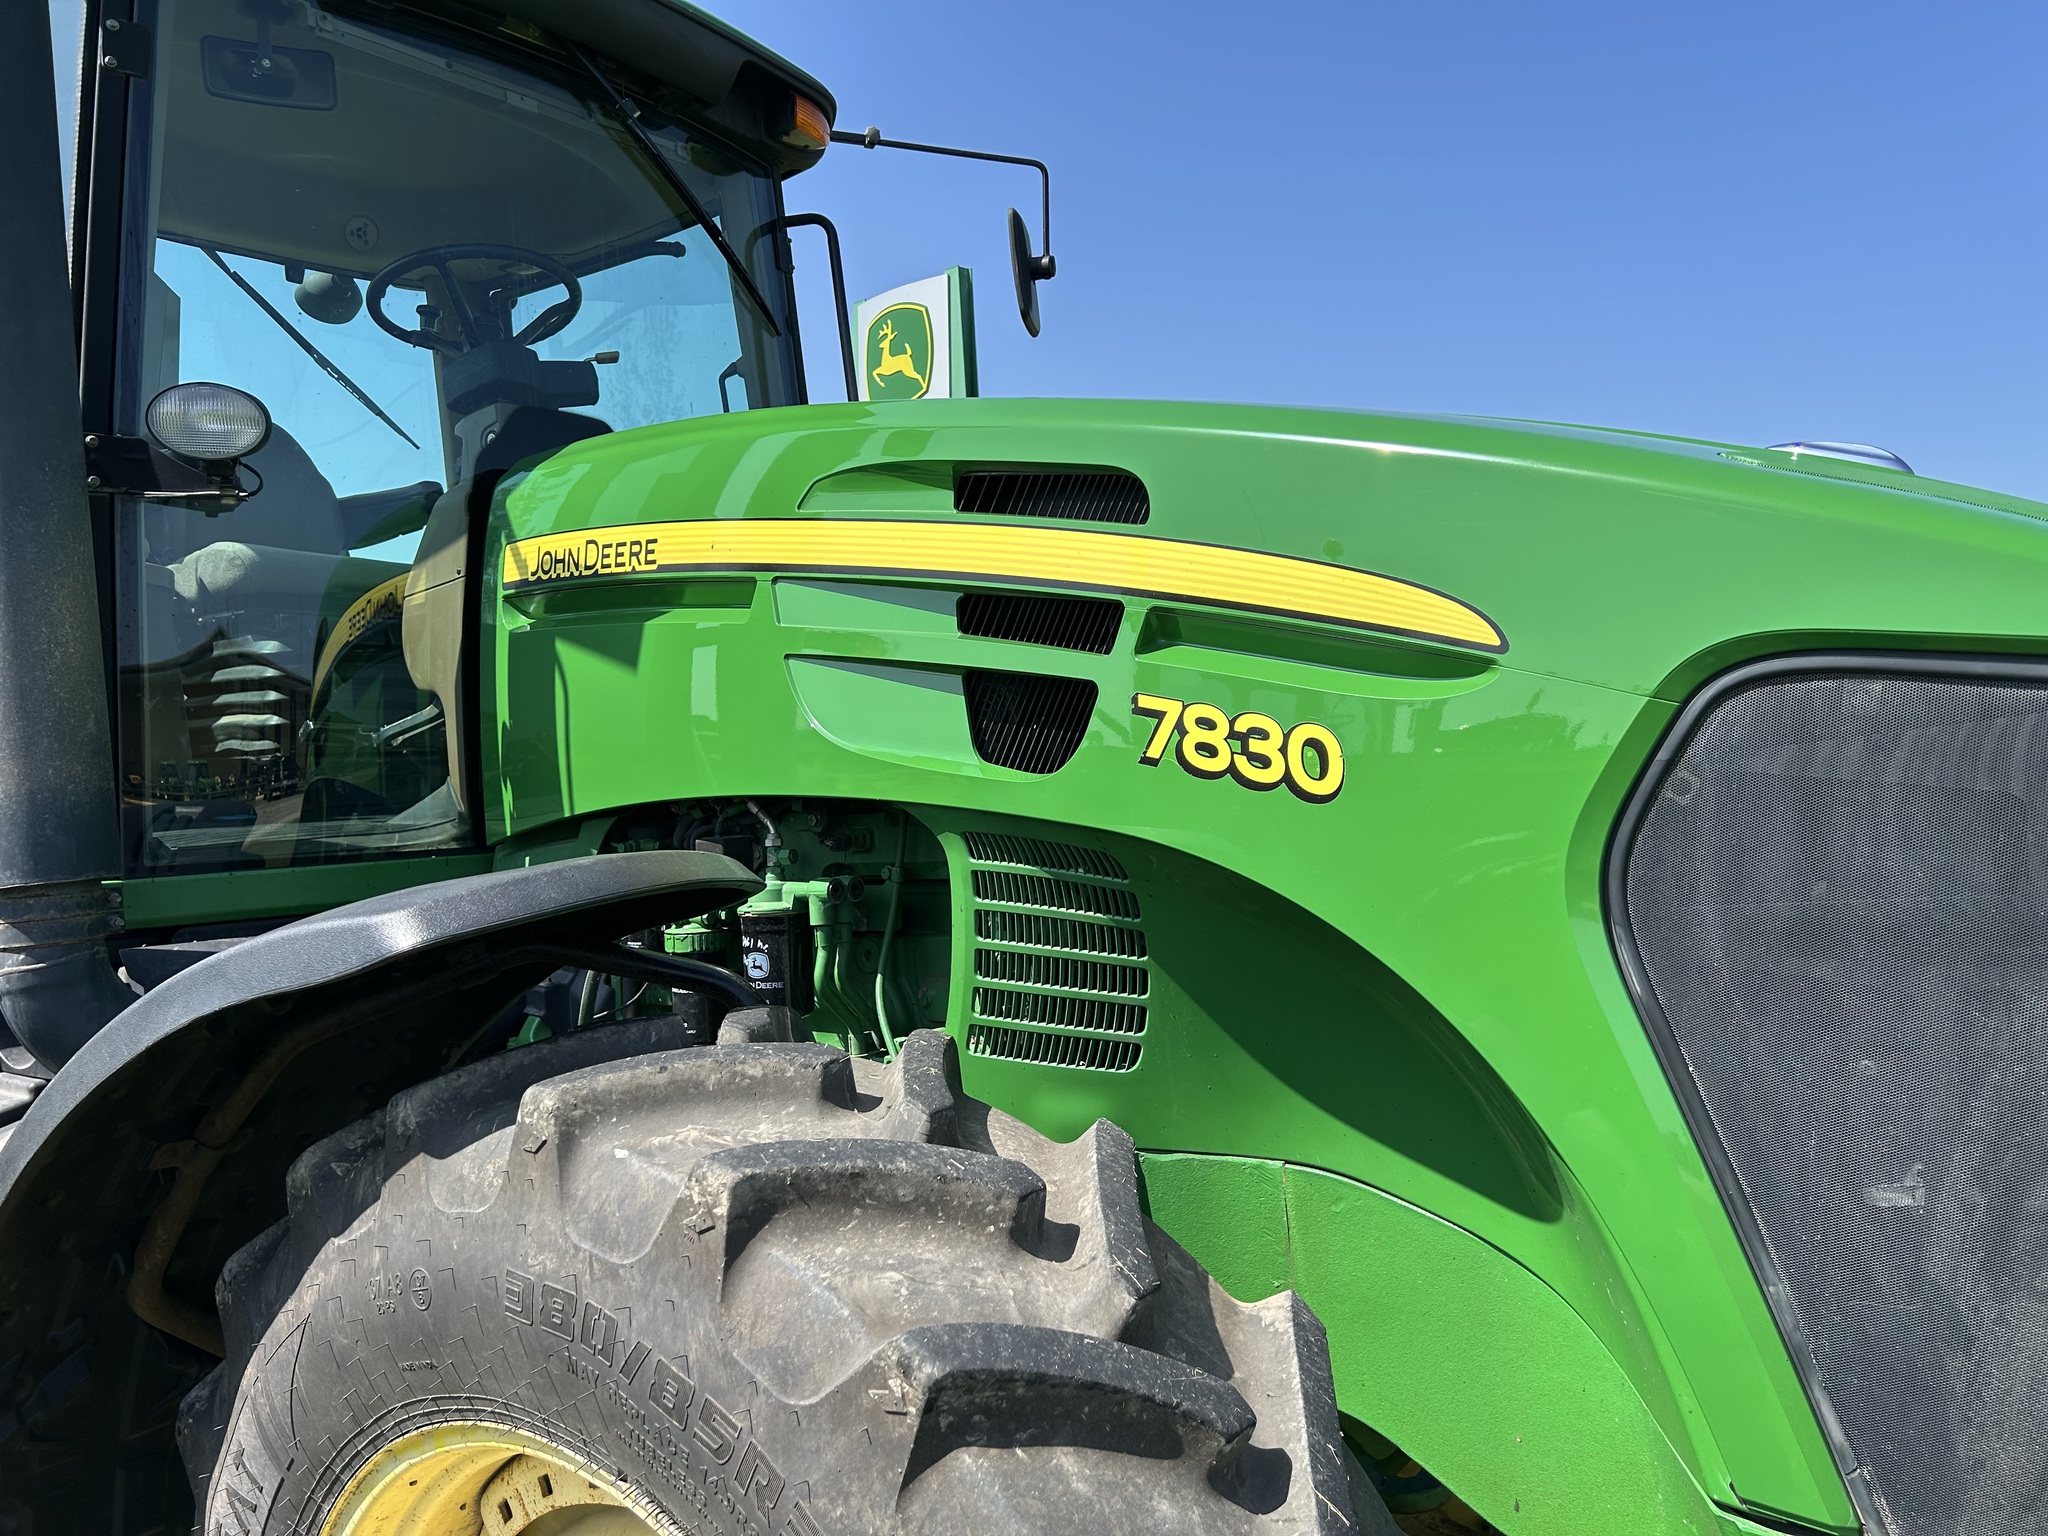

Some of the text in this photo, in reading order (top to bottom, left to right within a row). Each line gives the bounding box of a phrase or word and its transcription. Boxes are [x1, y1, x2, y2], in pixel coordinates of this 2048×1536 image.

[530, 538, 658, 577] JOHN DEERE
[1131, 692, 1345, 805] 7830
[755, 981, 784, 989] DEERE
[564, 1352, 600, 1390] MAY
[606, 1379, 690, 1469] REPLACE
[625, 1421, 708, 1508] TUBELESS
